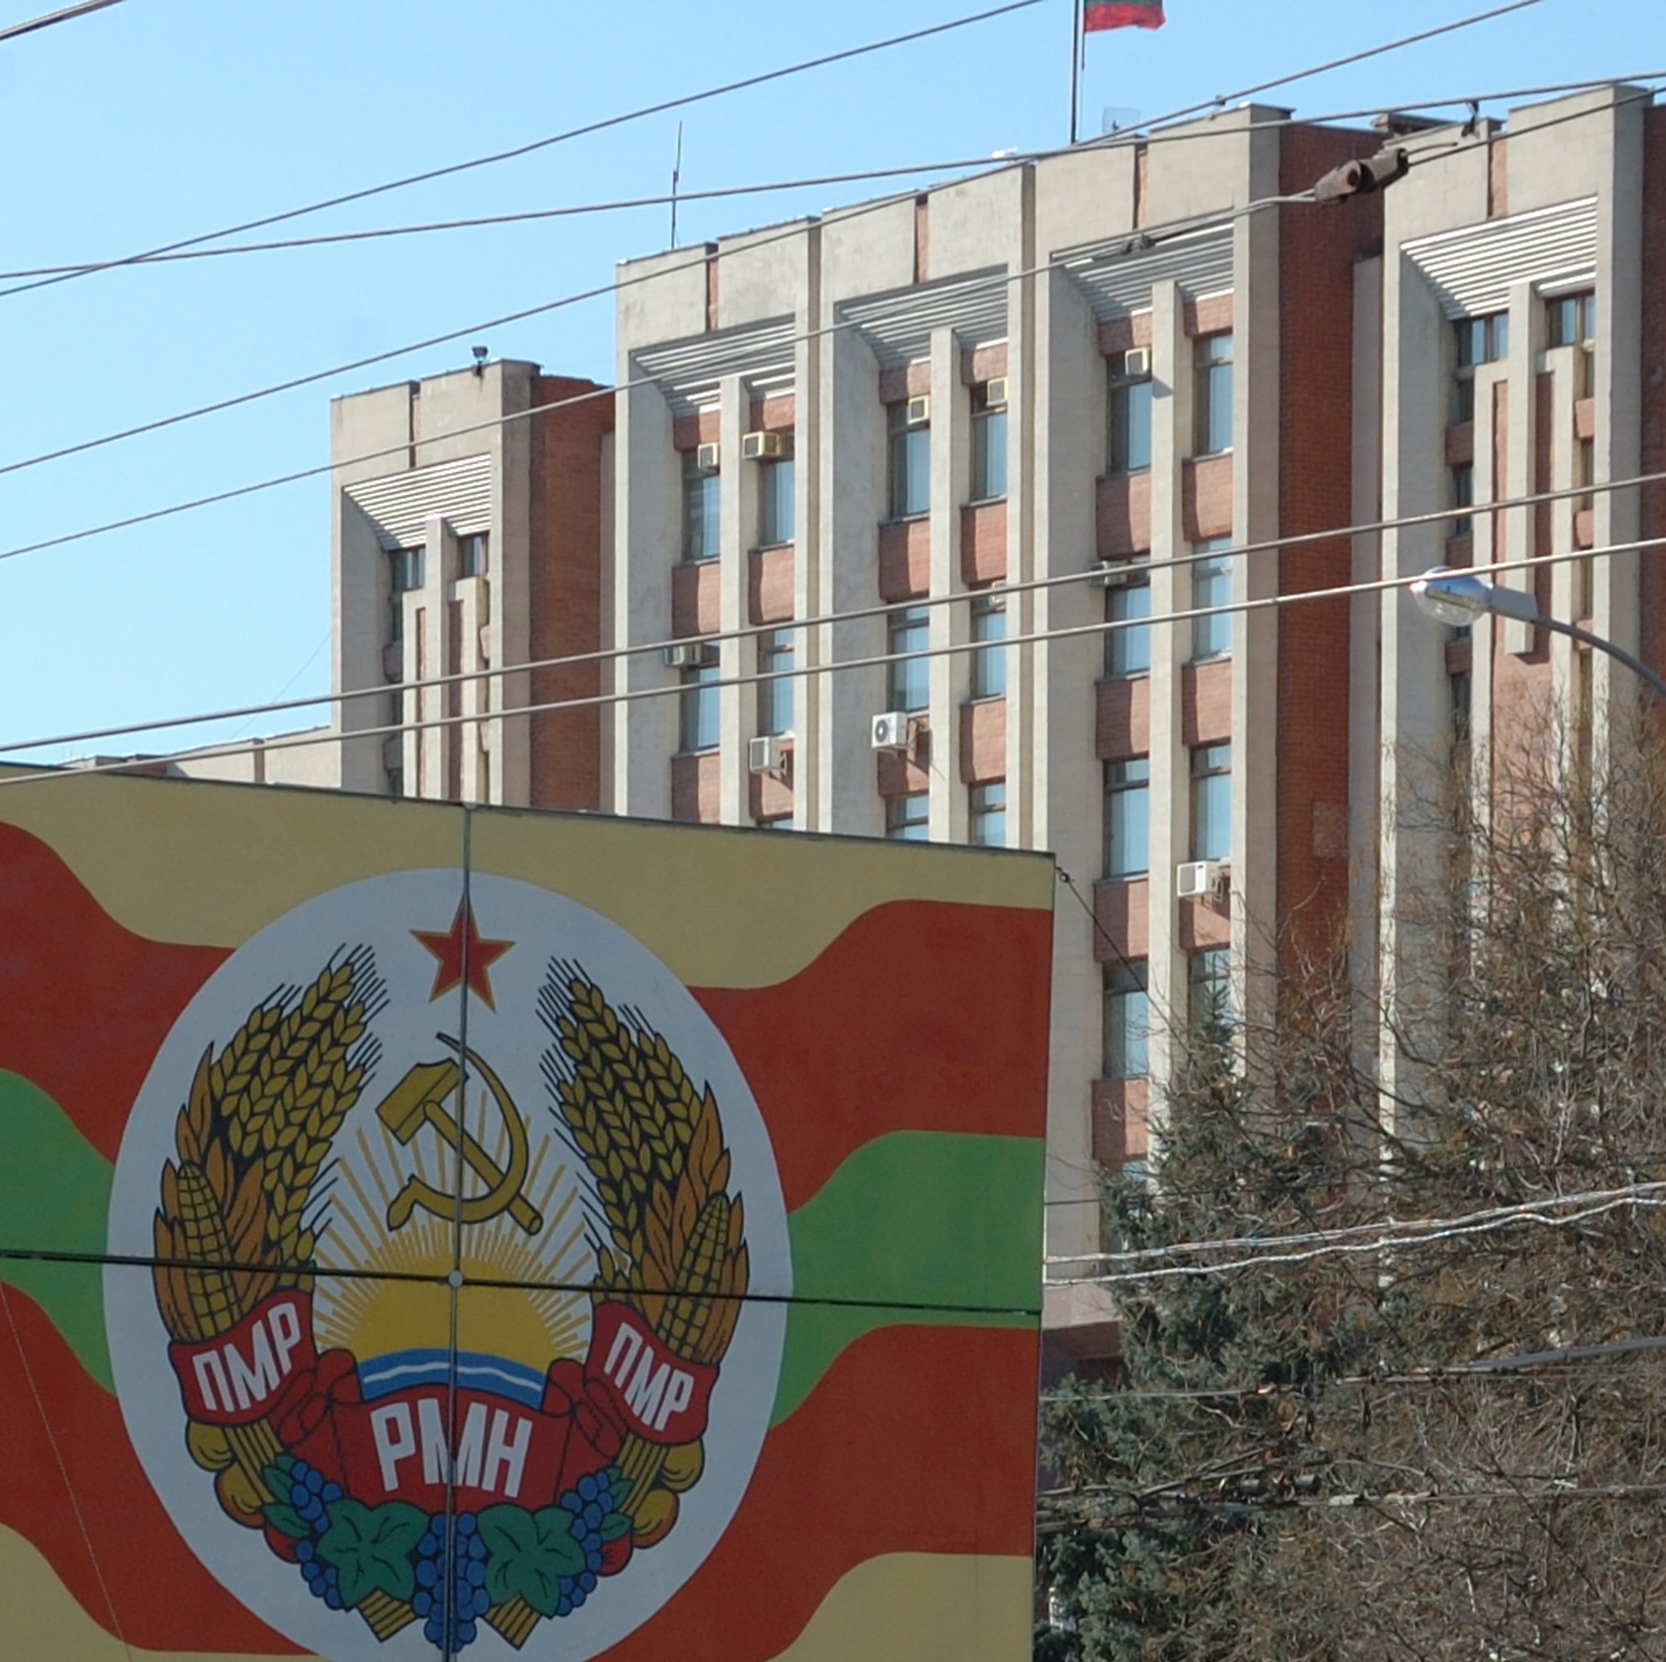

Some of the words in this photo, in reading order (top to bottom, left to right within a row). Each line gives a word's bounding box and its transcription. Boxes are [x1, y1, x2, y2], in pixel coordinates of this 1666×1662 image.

[191, 1302, 302, 1413] ПМР
[603, 1321, 695, 1432] ПМР
[369, 1397, 534, 1498] РМН
